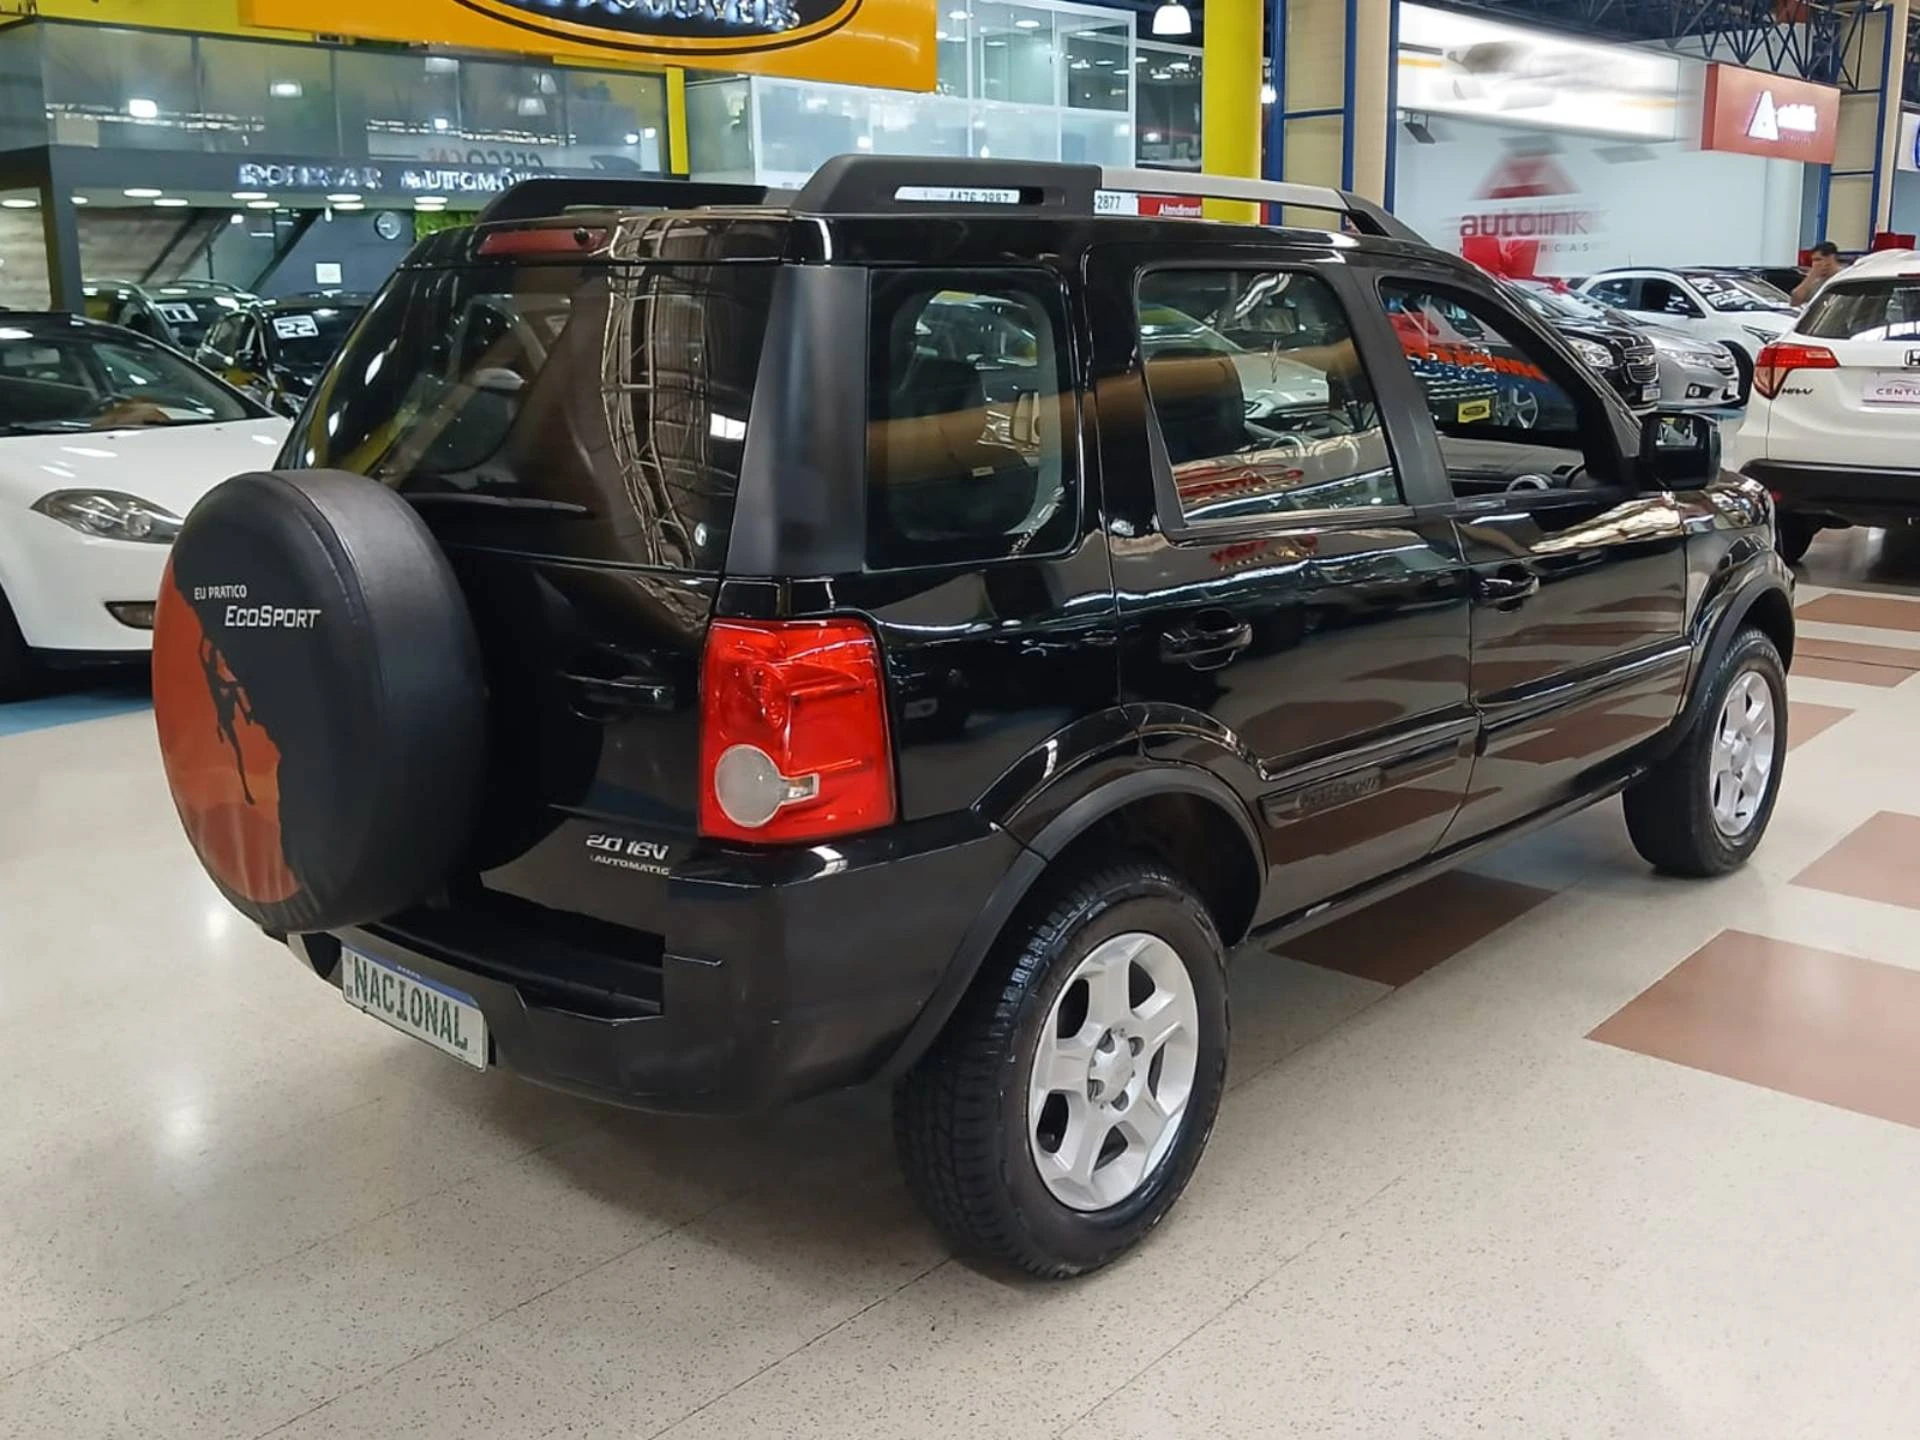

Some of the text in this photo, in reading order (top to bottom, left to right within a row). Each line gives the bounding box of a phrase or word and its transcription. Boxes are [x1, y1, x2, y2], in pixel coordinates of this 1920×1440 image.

[1459, 210, 1589, 237] autolink
[194, 585, 248, 601] EU PRATICO
[626, 840, 670, 860] 16V
[353, 955, 468, 1051] NACIONAL
